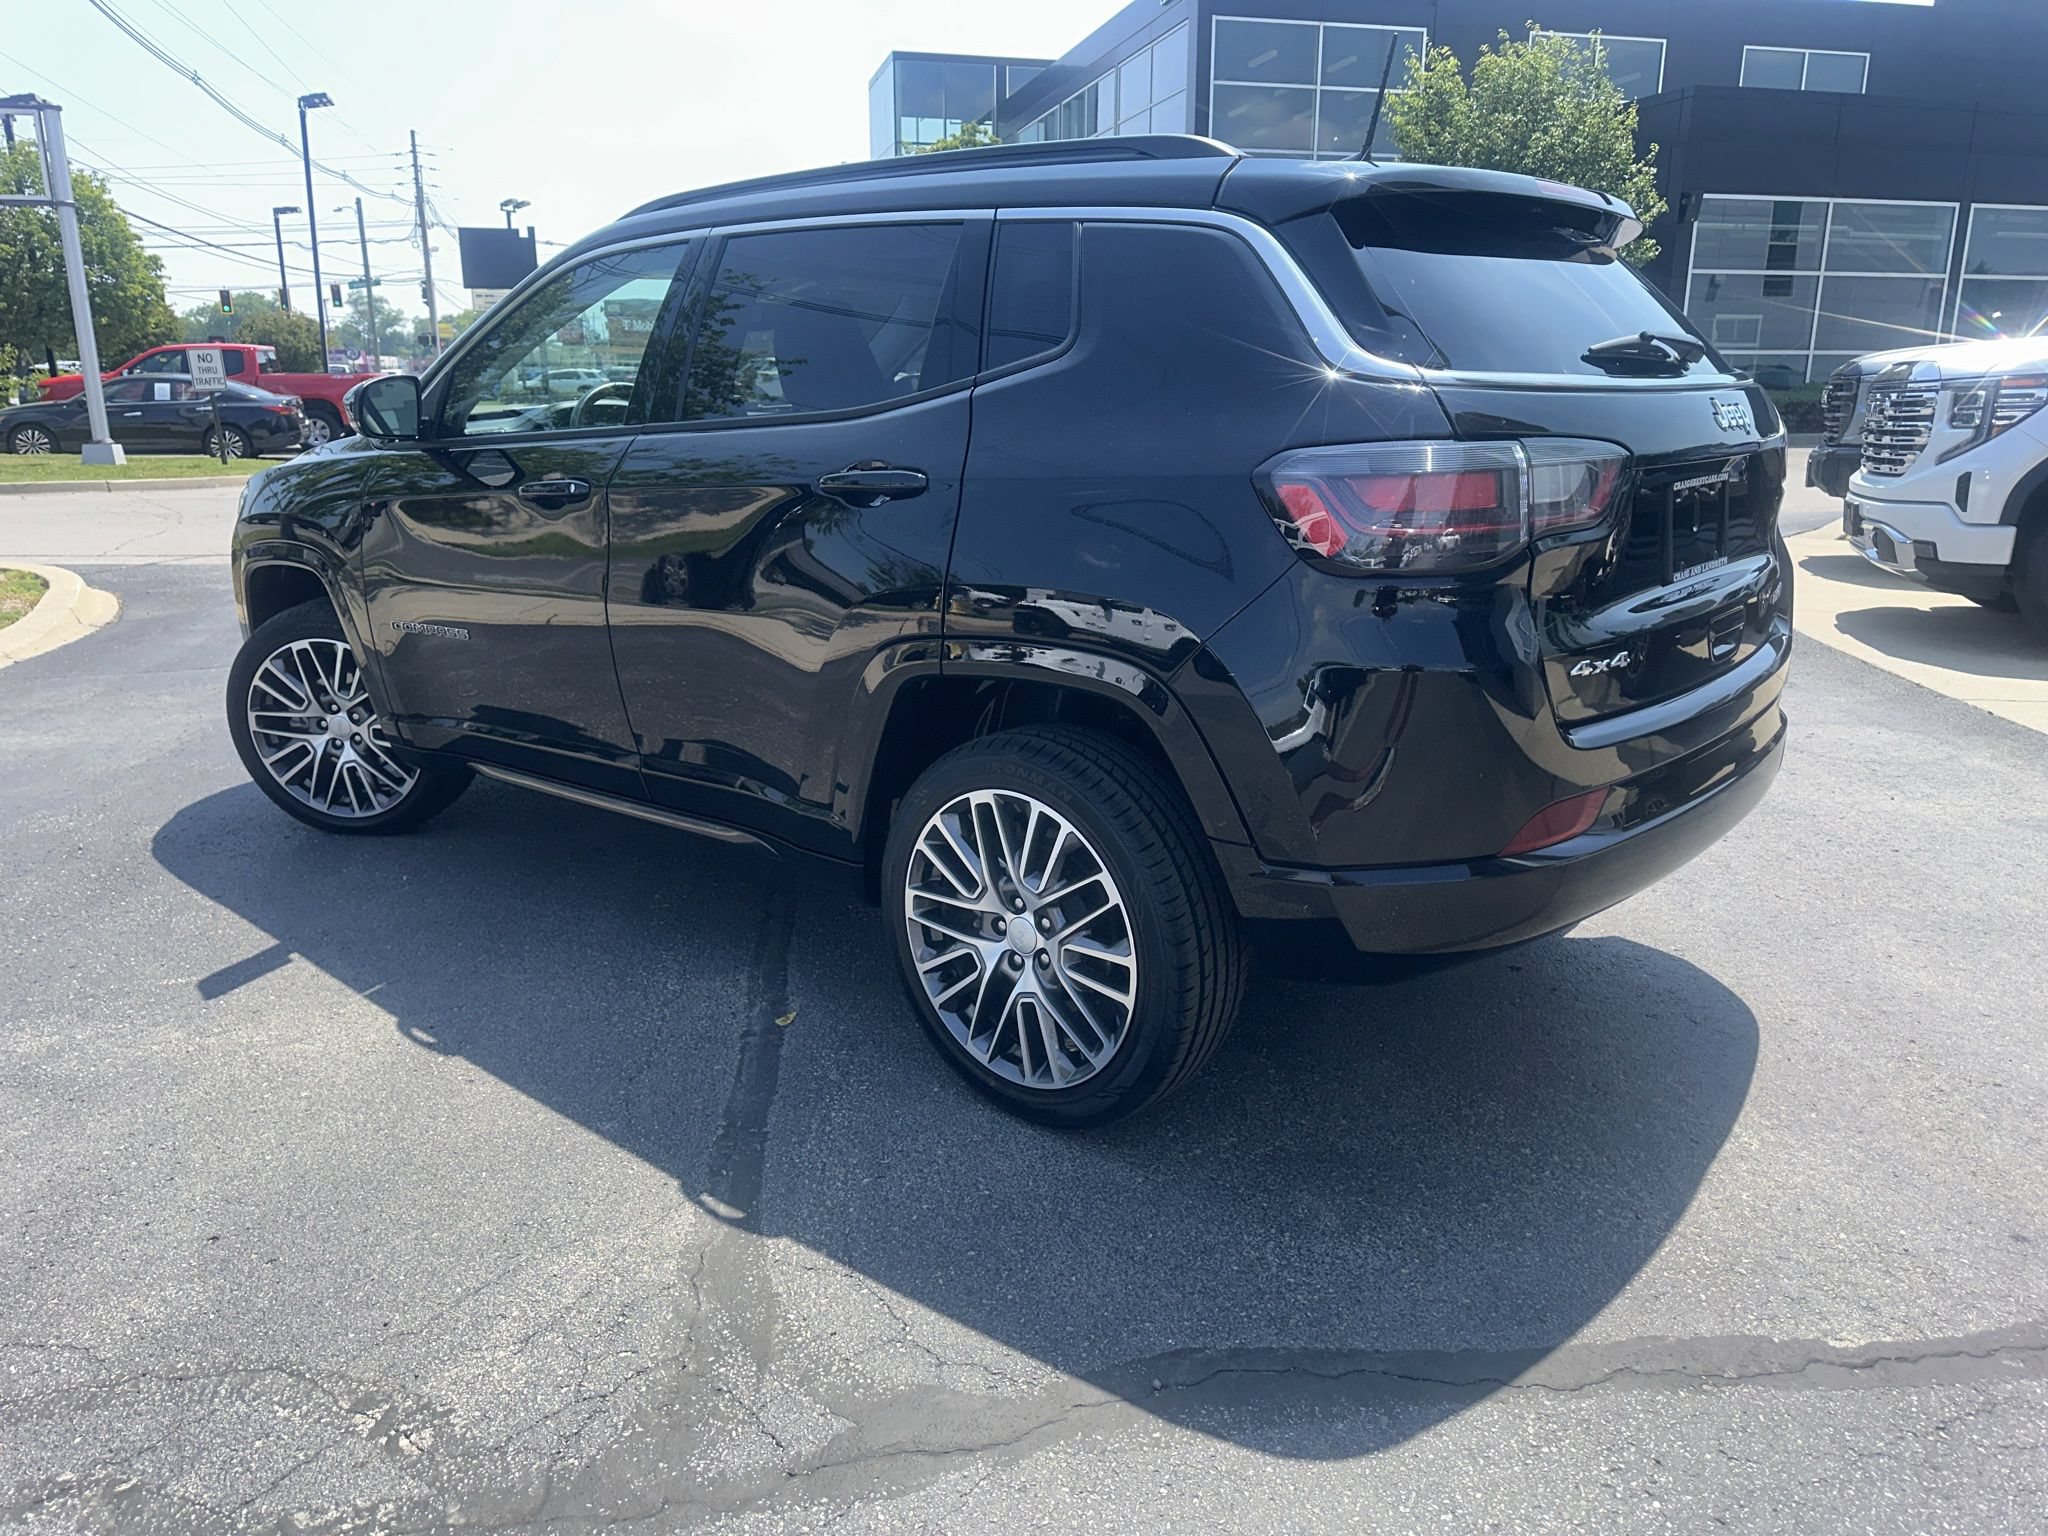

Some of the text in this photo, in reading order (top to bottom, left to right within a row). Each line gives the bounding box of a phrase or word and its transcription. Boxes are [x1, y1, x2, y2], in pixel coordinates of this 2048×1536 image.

[197, 352, 213, 363] NO
[198, 366, 217, 374] THRU
[195, 376, 224, 385] TRAFFIC
[1709, 397, 1750, 435] Jeep
[391, 621, 470, 640] COMPASS
[1570, 651, 1630, 676] 4x4
